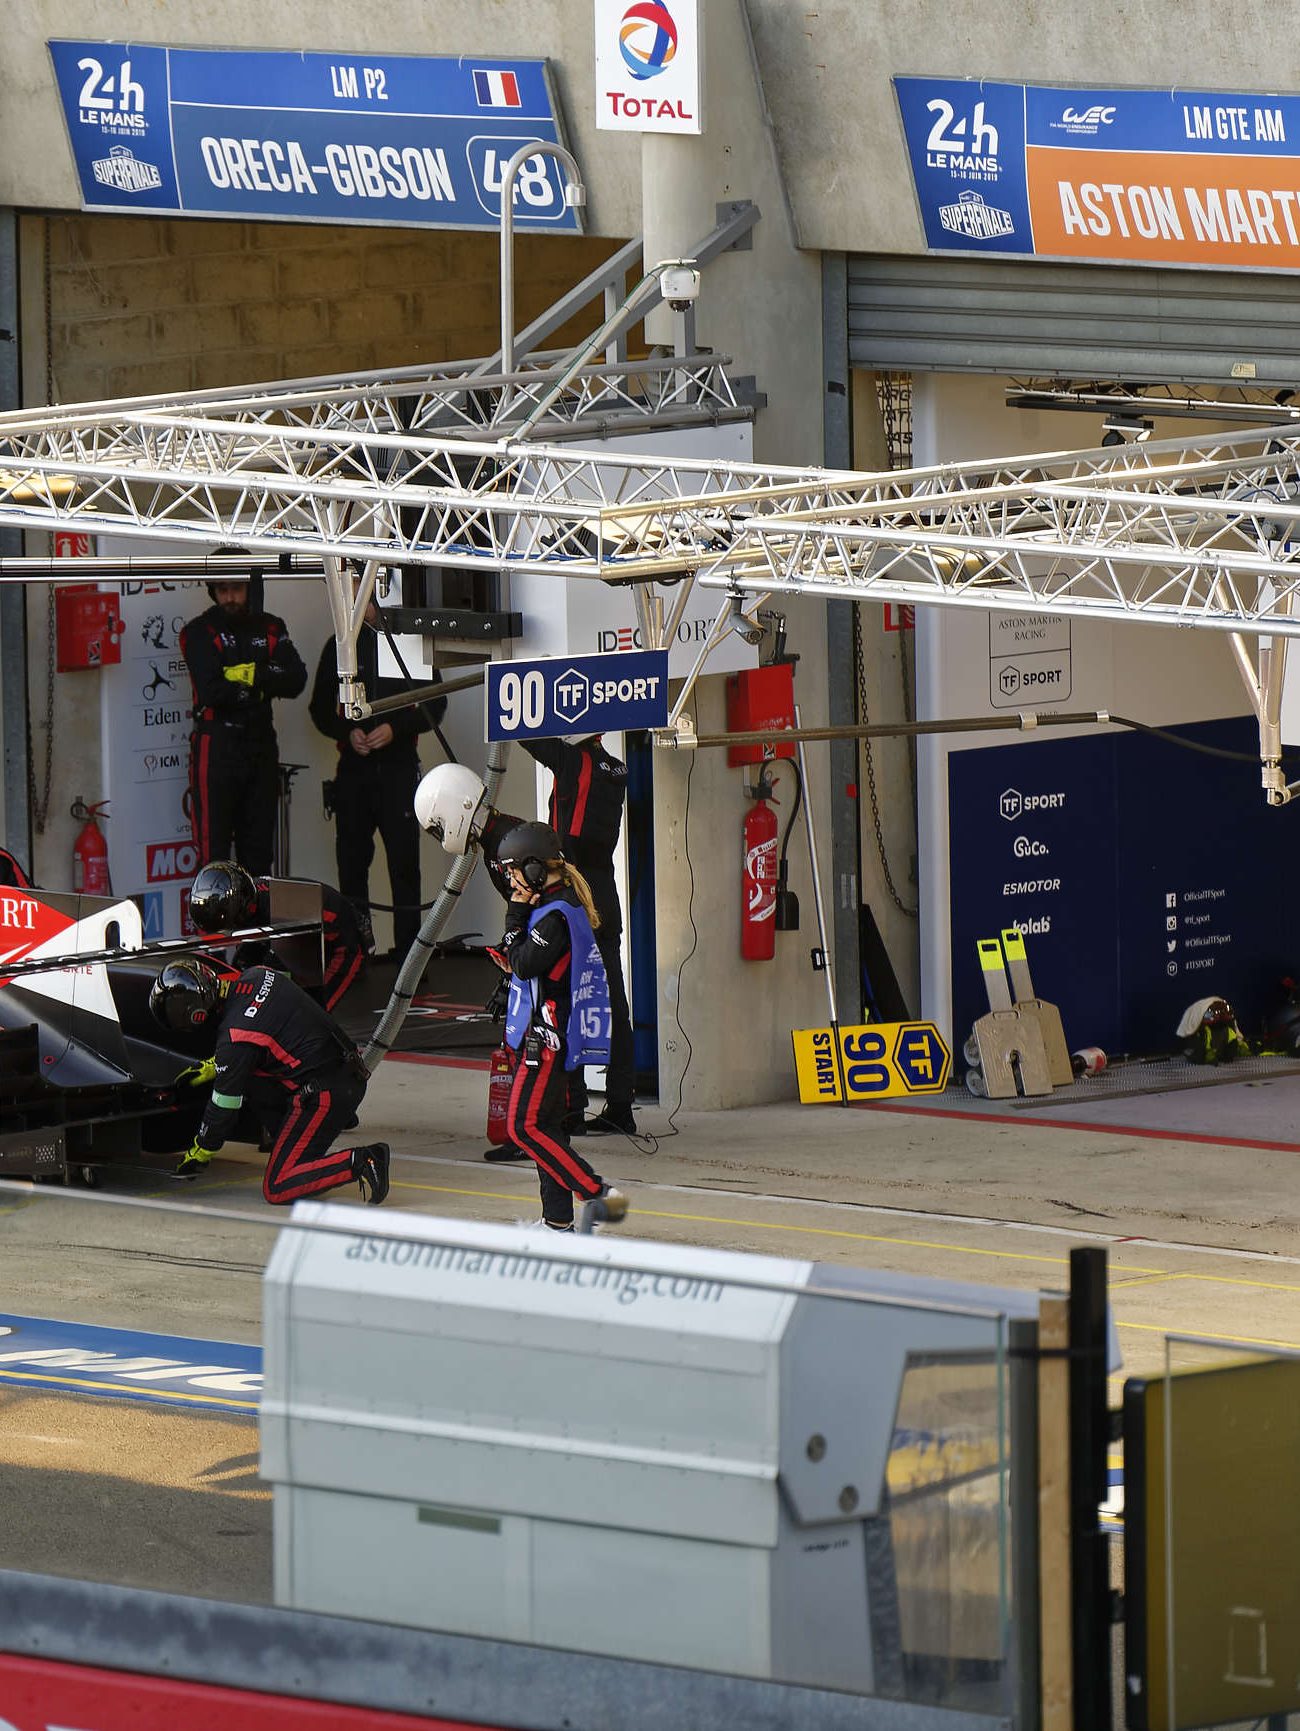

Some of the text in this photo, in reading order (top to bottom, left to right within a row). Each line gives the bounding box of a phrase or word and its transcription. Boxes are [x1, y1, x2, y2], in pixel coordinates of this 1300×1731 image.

[77, 57, 145, 112] 24h
[330, 65, 389, 101] LM P2
[79, 109, 145, 128] LE MANS
[605, 91, 693, 120] TOTAL
[1062, 105, 1117, 125] WEC
[926, 98, 999, 155] 24h
[1183, 105, 1286, 142] LM GTE AM
[95, 156, 161, 191] SUPERFINALE
[200, 136, 457, 203] ORECA-GIBSON
[483, 149, 554, 207] 48
[926, 152, 999, 172] LE MANS
[941, 202, 1013, 238] SUPERFINALE
[1058, 181, 1300, 247] ASTON MART
[998, 618, 1026, 630] ASTON
[1014, 629, 1046, 641] RACING
[1002, 669, 1062, 688] TF SPORT
[500, 670, 660, 731] 90 TF SPORT
[144, 708, 181, 727] Eden
[160, 755, 180, 769] ICM
[1003, 793, 1065, 812] TF SPORT
[1002, 878, 1061, 895] ESMOTOR
[1012, 917, 1050, 936] kolab
[259, 970, 276, 997] SPORT
[812, 1032, 836, 1096] START
[844, 1032, 890, 1092] 90
[908, 1035, 933, 1079] TF
